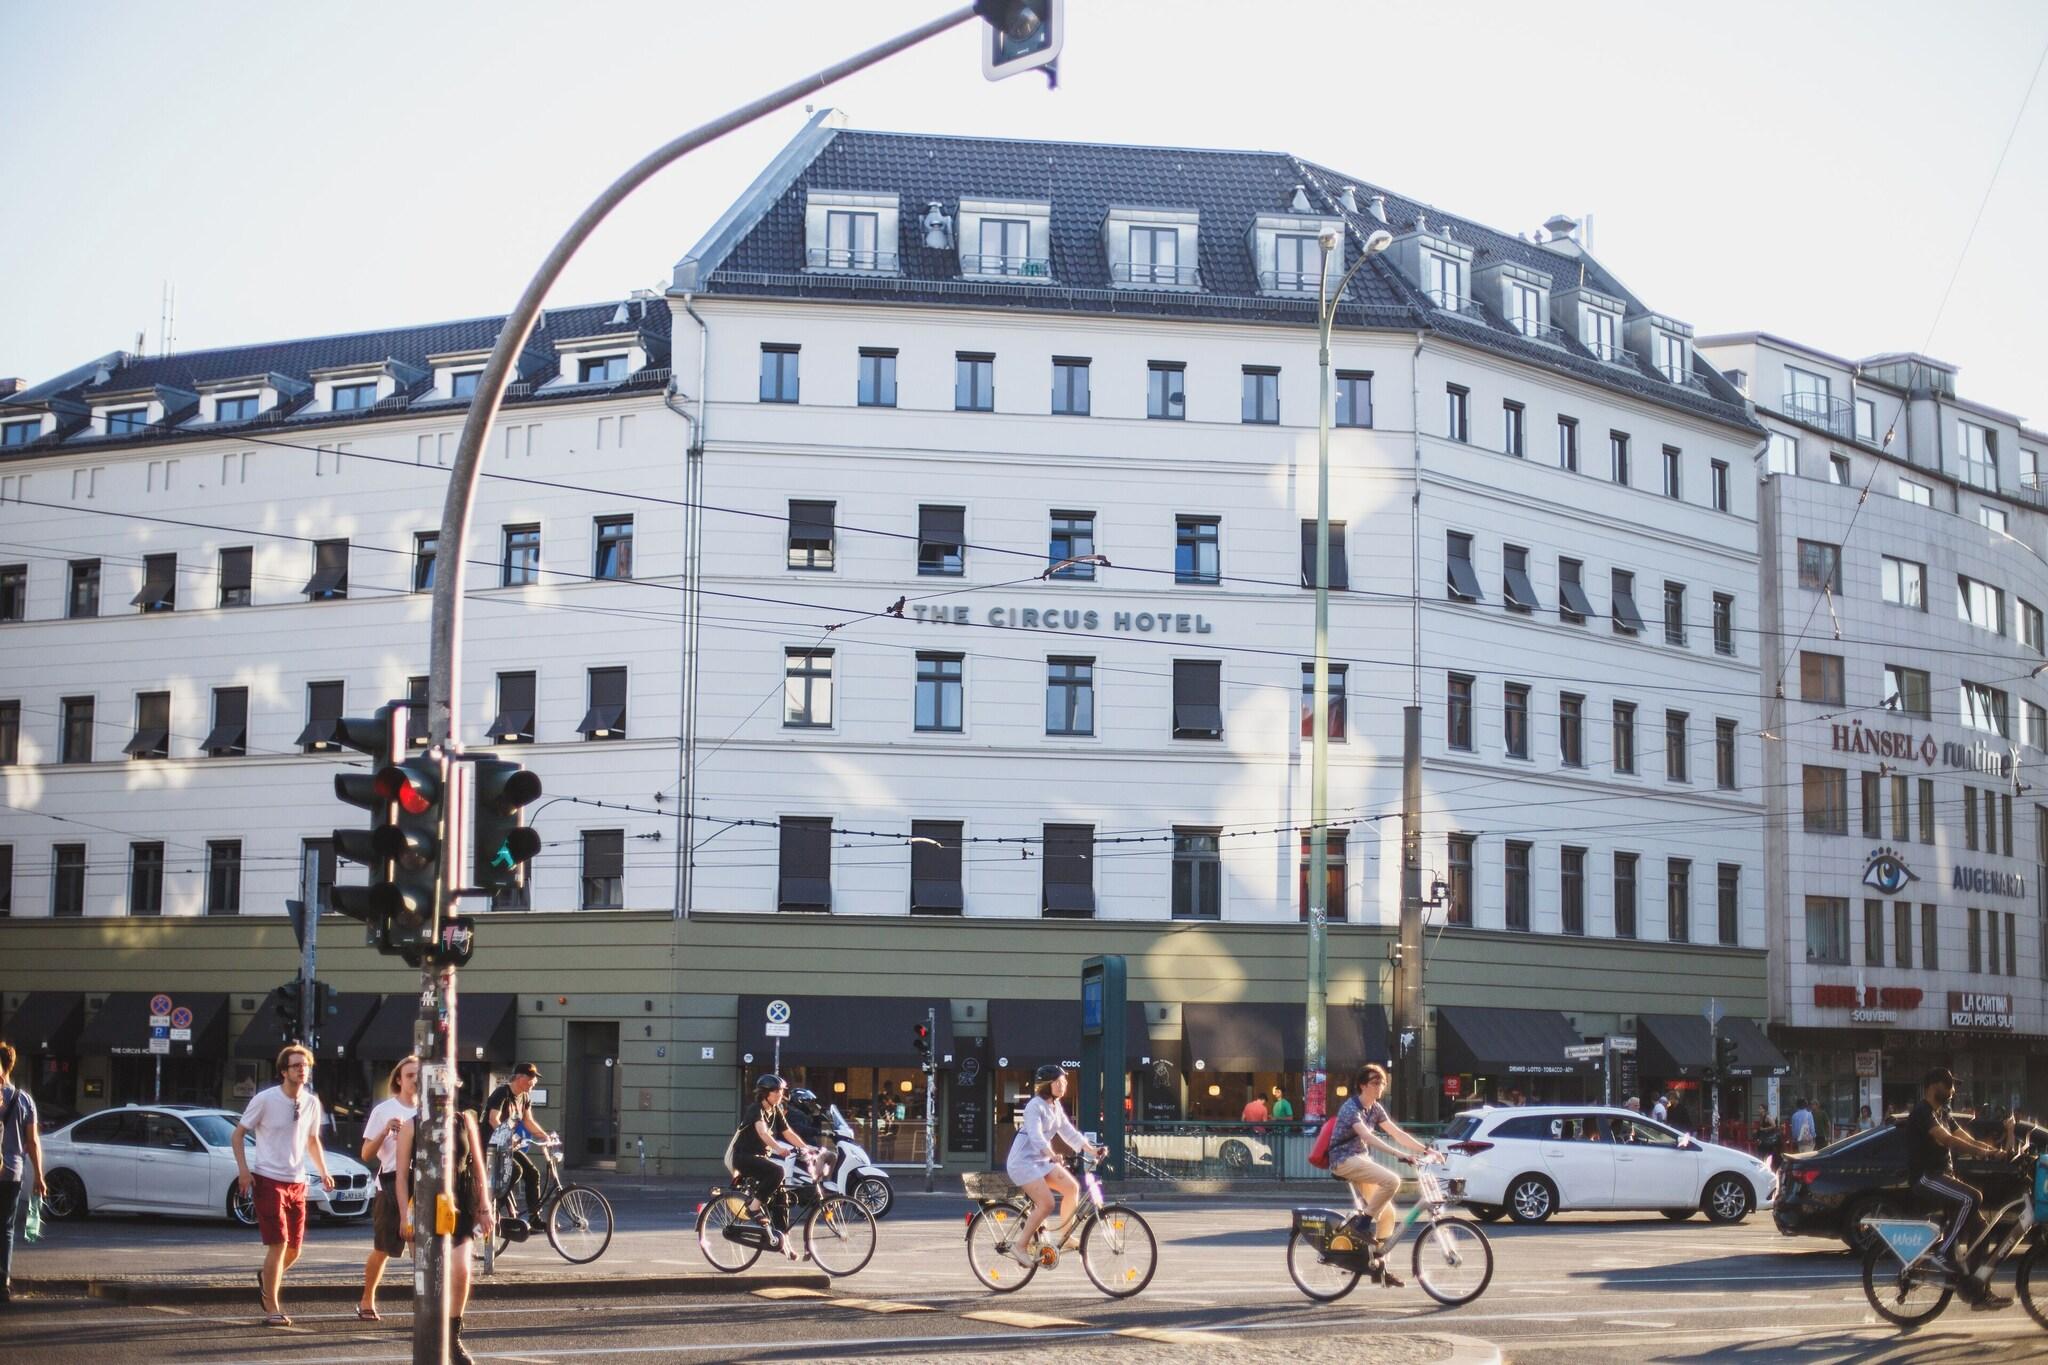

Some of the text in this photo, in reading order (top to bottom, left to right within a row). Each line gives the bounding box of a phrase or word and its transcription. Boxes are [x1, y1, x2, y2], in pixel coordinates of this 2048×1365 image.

[913, 604, 1212, 634] THE CIRCUS HOTEL
[1832, 719, 1919, 761] HÄNSEL
[1943, 740, 2011, 779] runtime
[1962, 993, 1974, 1011] LA
[1951, 1012, 1974, 1025] PIZZA
[1975, 1013, 1996, 1027] PASTA
